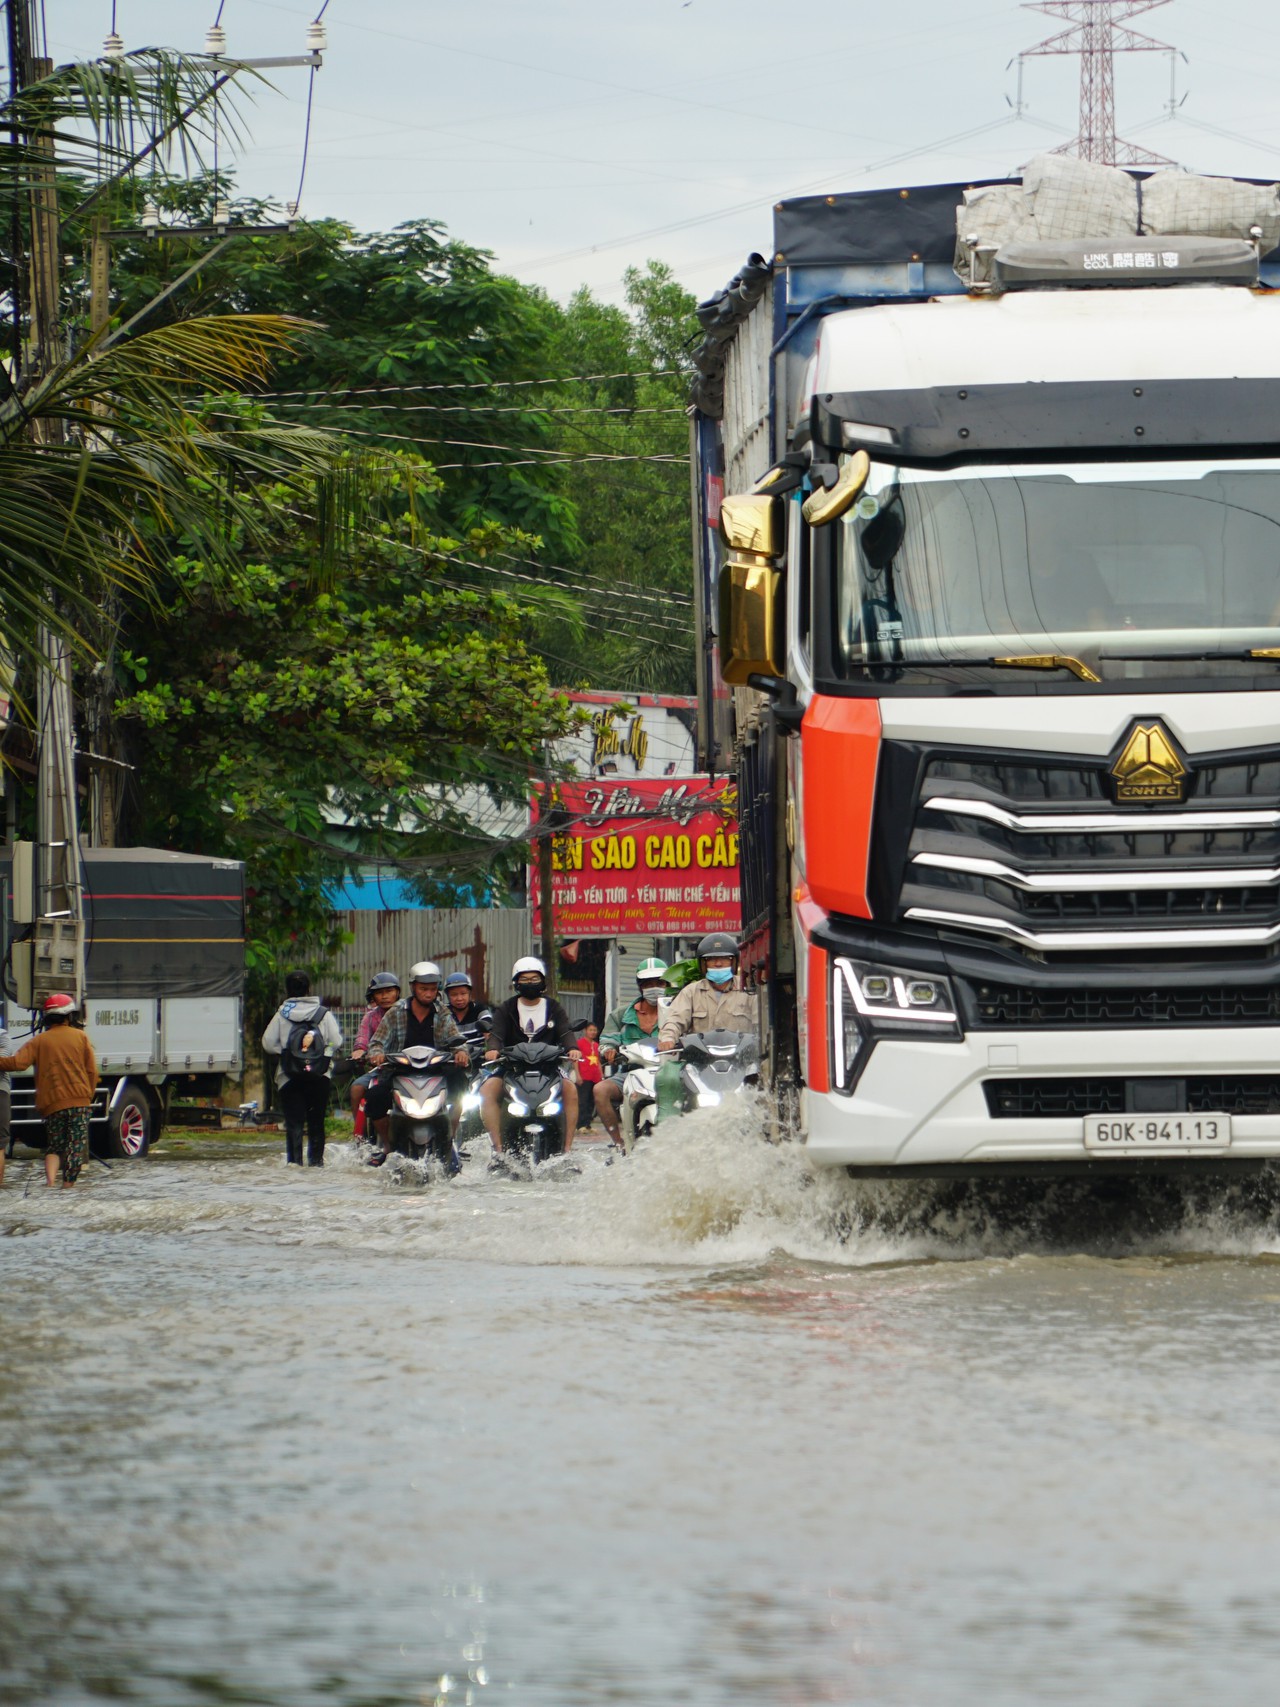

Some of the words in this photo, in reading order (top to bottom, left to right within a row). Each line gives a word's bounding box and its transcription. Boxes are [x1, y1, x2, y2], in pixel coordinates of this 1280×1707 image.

[1083, 253, 1109, 261] LINK
[1083, 261, 1112, 269] COOL
[1121, 786, 1176, 796] CNHTC
[645, 834, 691, 868] CAO
[584, 885, 603, 904] YẾN
[637, 884, 656, 902] YẾN
[659, 887, 682, 902] TINH
[684, 884, 704, 902] CHẾ
[1097, 1121, 1218, 1141] 60K-841.13
